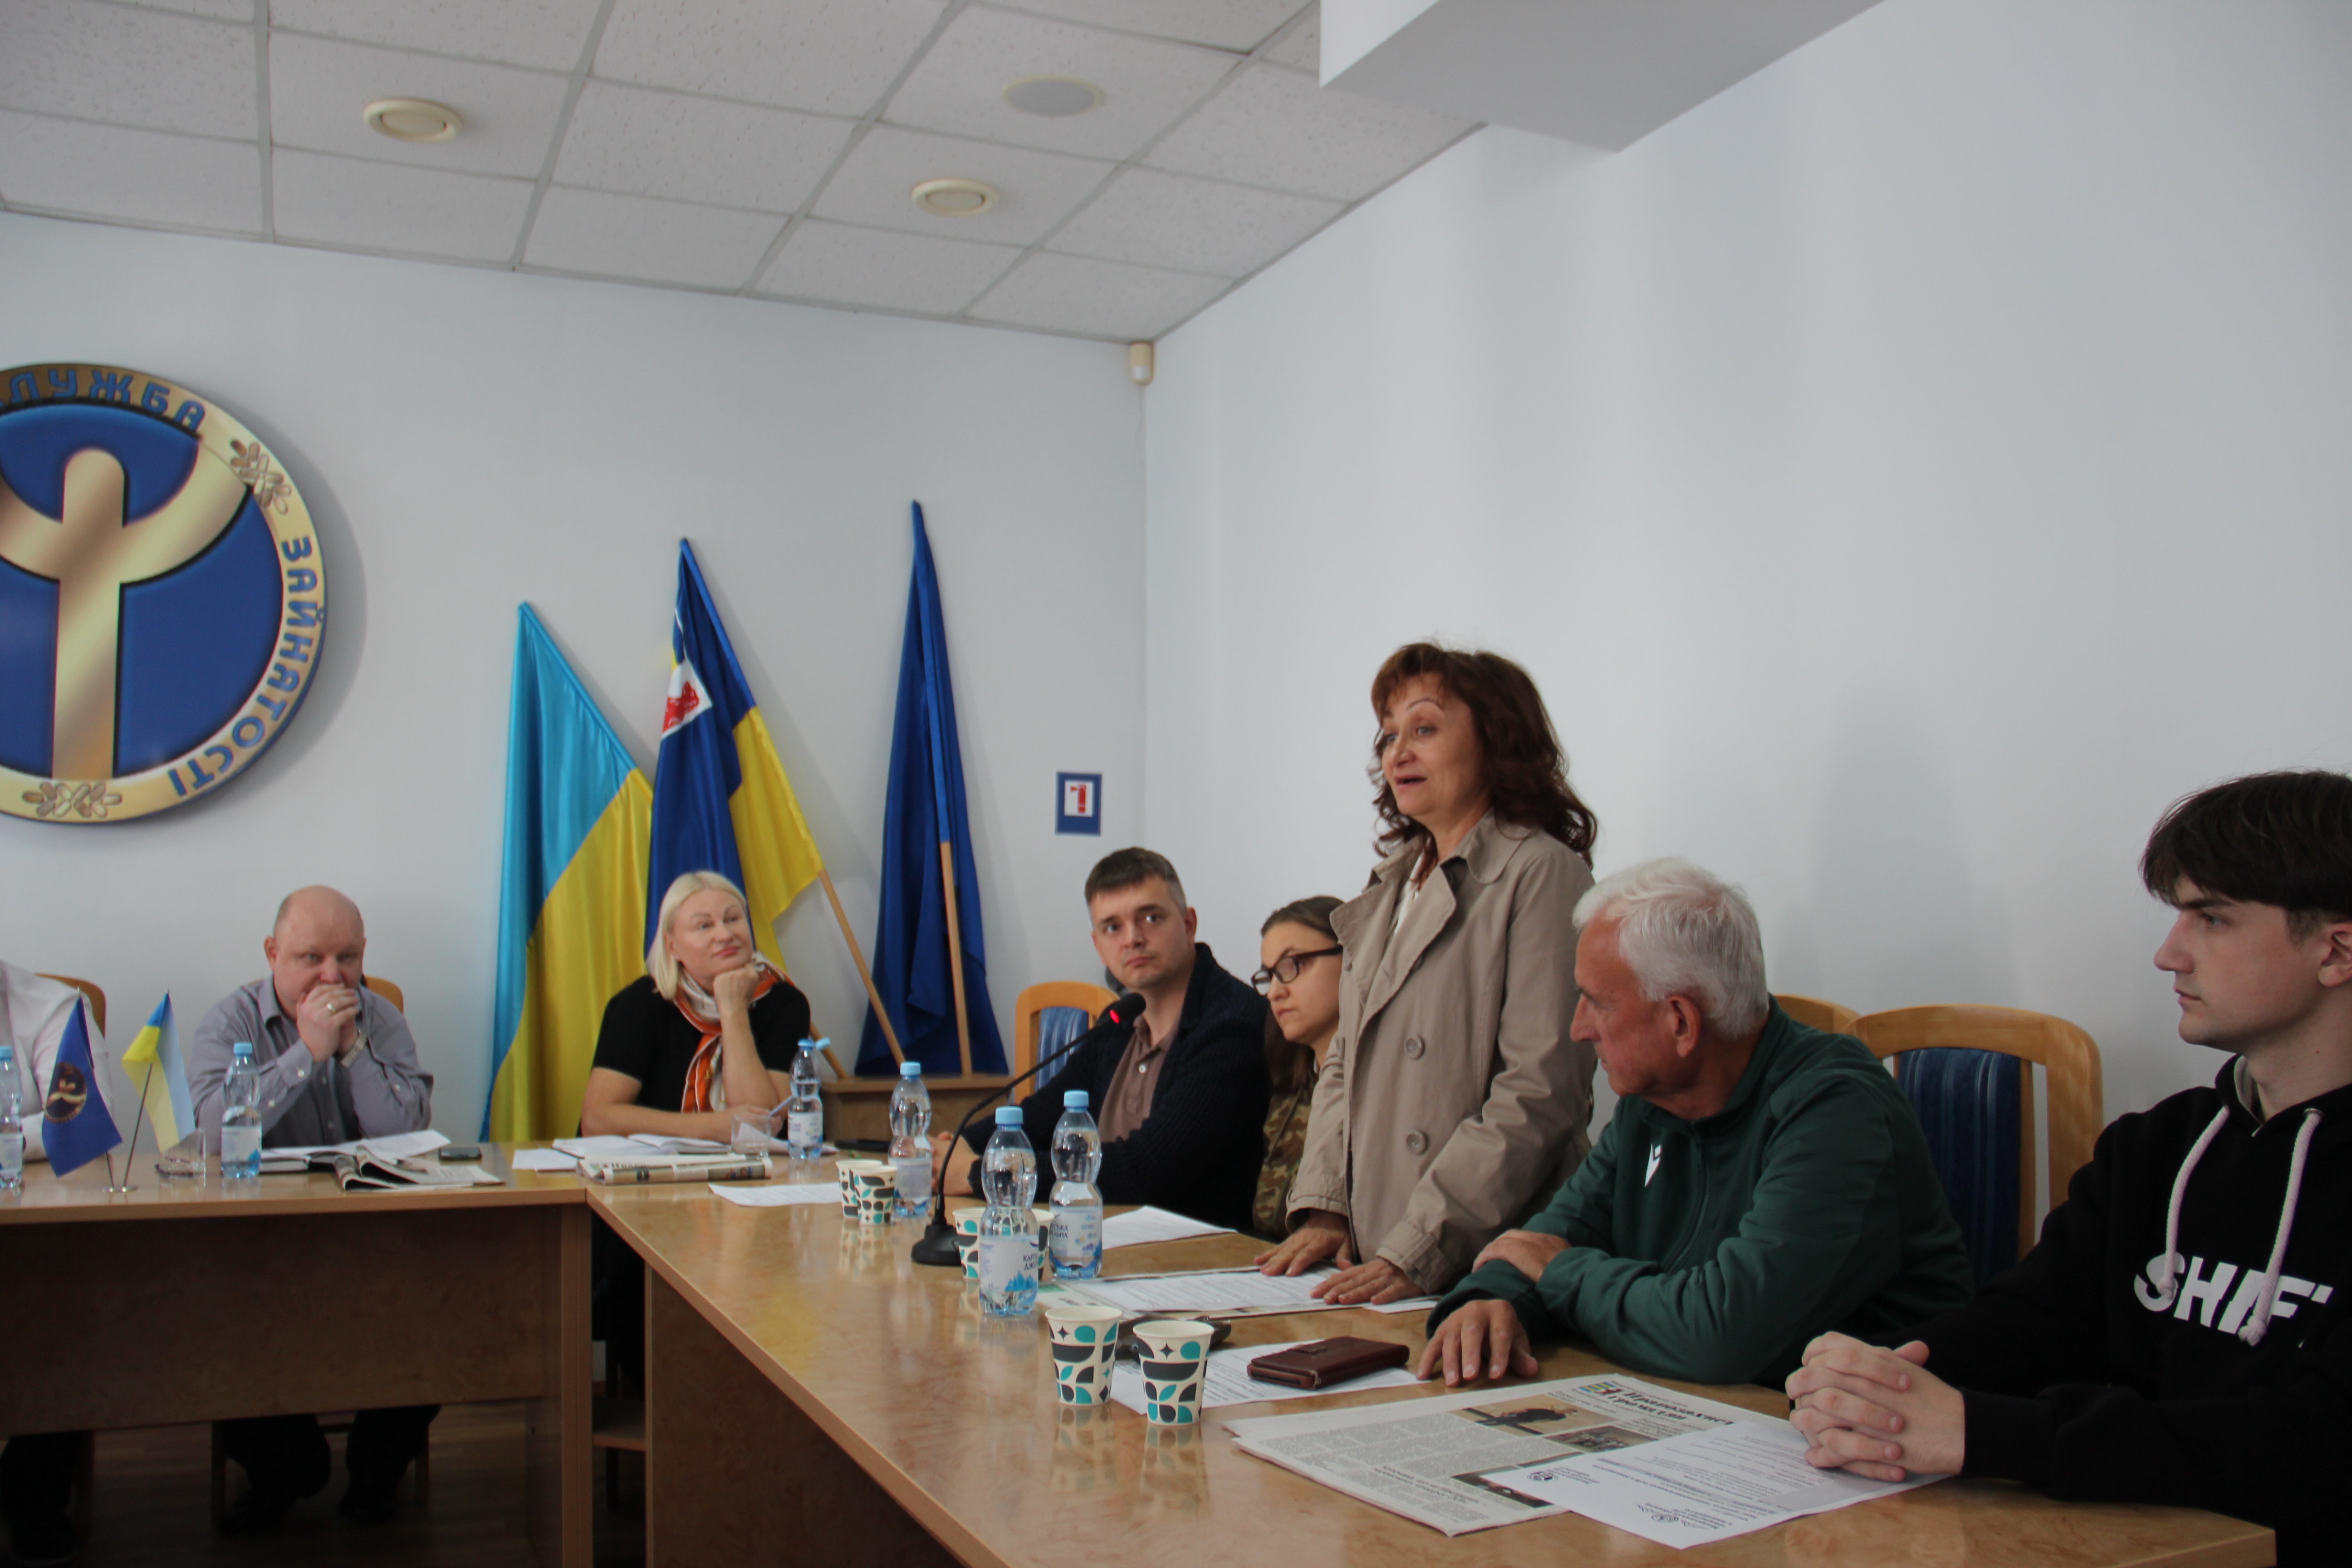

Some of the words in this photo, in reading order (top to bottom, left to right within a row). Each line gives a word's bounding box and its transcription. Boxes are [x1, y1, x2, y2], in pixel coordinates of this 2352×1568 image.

[0, 370, 206, 433] ЛУЖБА
[167, 535, 324, 797] ЗАЙНЯТОСТІ
[2134, 1251, 2333, 1338] SHIF
